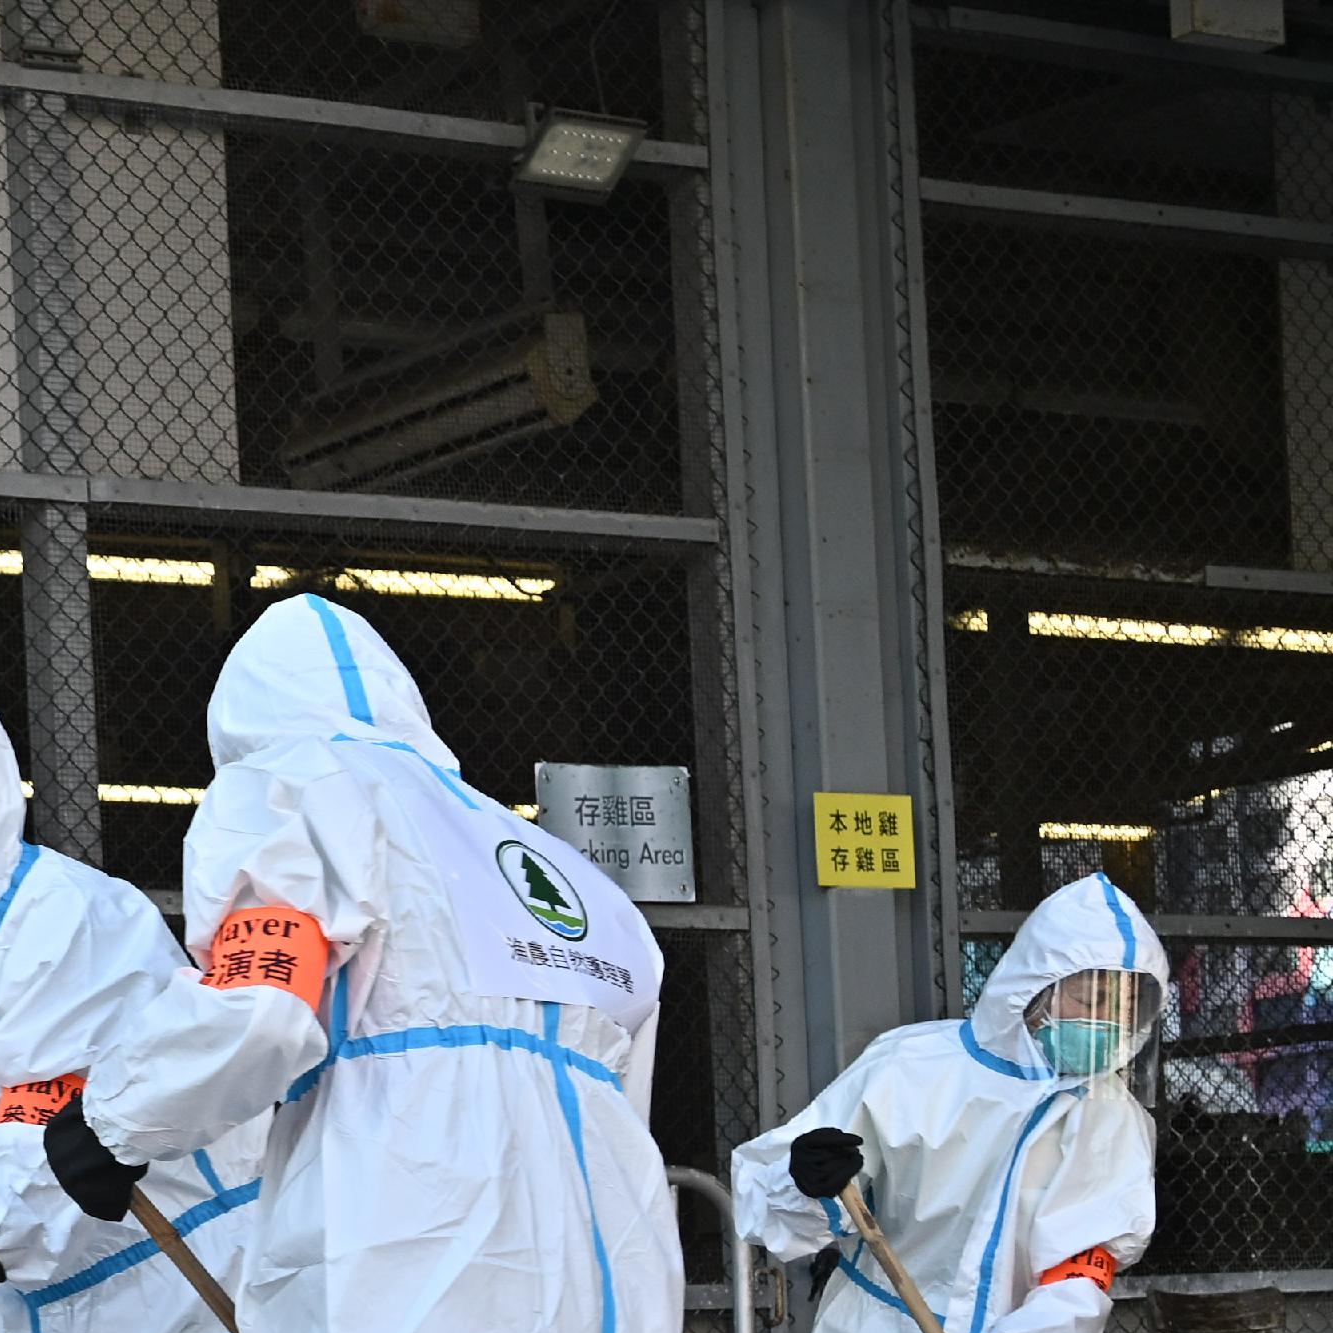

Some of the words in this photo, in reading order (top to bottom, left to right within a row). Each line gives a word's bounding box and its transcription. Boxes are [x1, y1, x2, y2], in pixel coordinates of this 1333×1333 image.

[574, 795, 656, 827] 存雞區
[829, 809, 899, 837] 本地雞
[639, 841, 684, 865] Area
[830, 846, 900, 873] 存雞區
